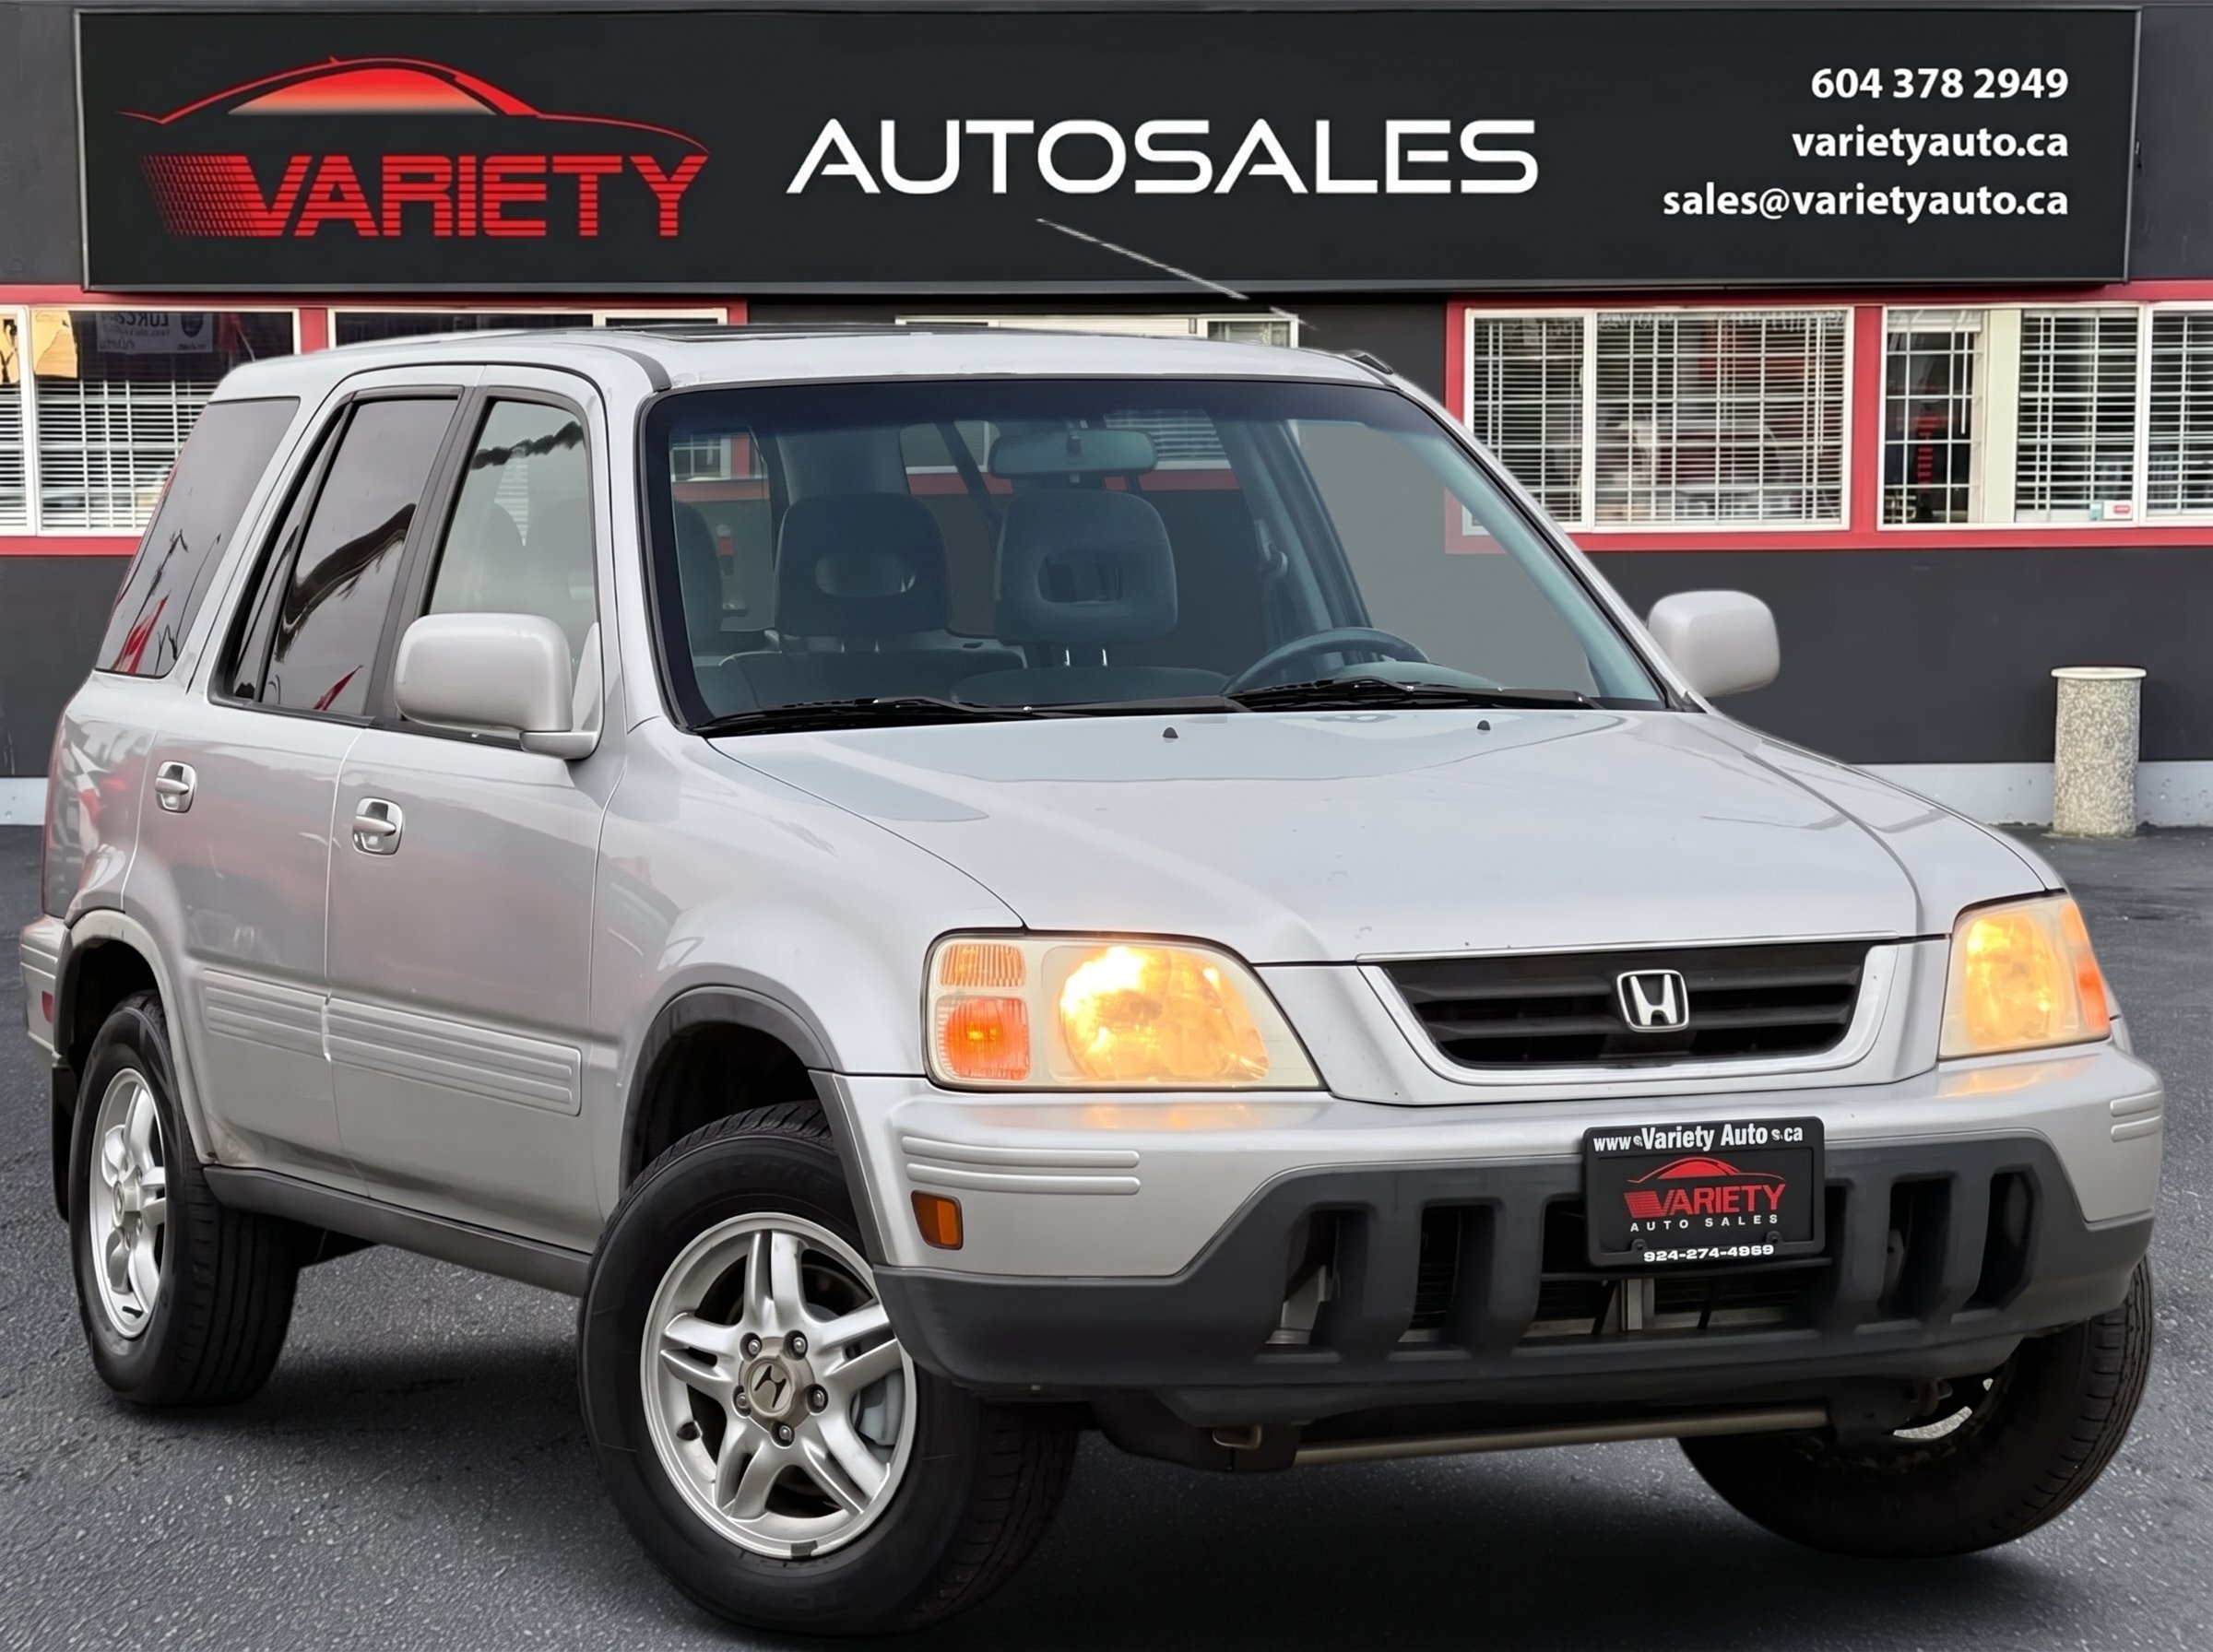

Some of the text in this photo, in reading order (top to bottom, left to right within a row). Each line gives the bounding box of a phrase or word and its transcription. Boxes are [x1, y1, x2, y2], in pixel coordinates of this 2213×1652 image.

[1811, 67, 2069, 99] 604 378 2949
[786, 118, 1539, 195] AUTOSALES
[1792, 124, 2068, 167] varietyauto.ca
[142, 153, 708, 238] VARIETY
[1663, 181, 2068, 225] sales@varietyauto.ca
[1624, 1183, 1785, 1218] VARIETY
[1629, 1213, 1778, 1233] AUTO SALES
[1643, 1245, 1775, 1263] 924-274-4969
